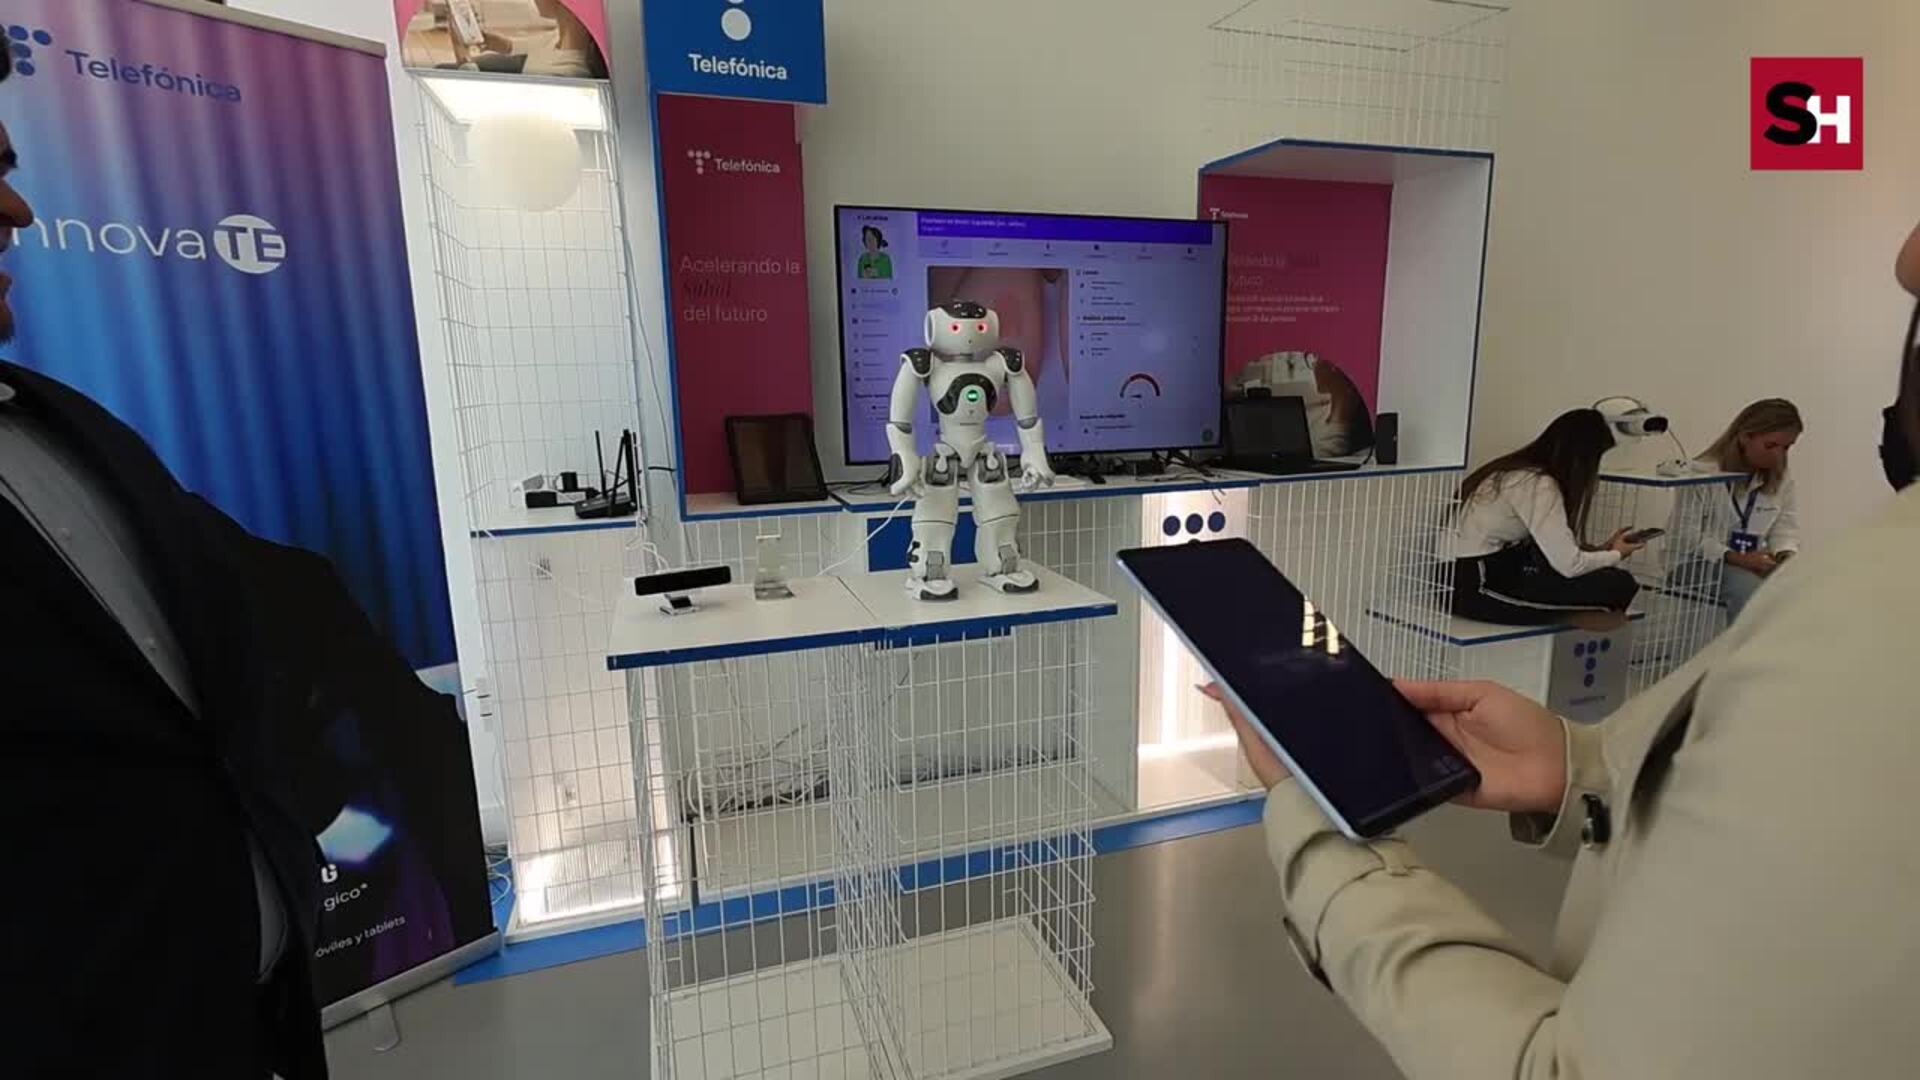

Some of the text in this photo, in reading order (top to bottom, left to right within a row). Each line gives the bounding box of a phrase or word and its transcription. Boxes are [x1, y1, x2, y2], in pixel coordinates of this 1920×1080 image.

[66, 50, 241, 101] Telefónica
[688, 53, 787, 80] Telefónica
[714, 158, 781, 174] Telefónica
[679, 255, 801, 274] Acelerando la
[683, 304, 768, 322] del futuro
[320, 863, 339, 884] G
[323, 883, 368, 912] gico
[314, 915, 406, 958] óviles y tablets
